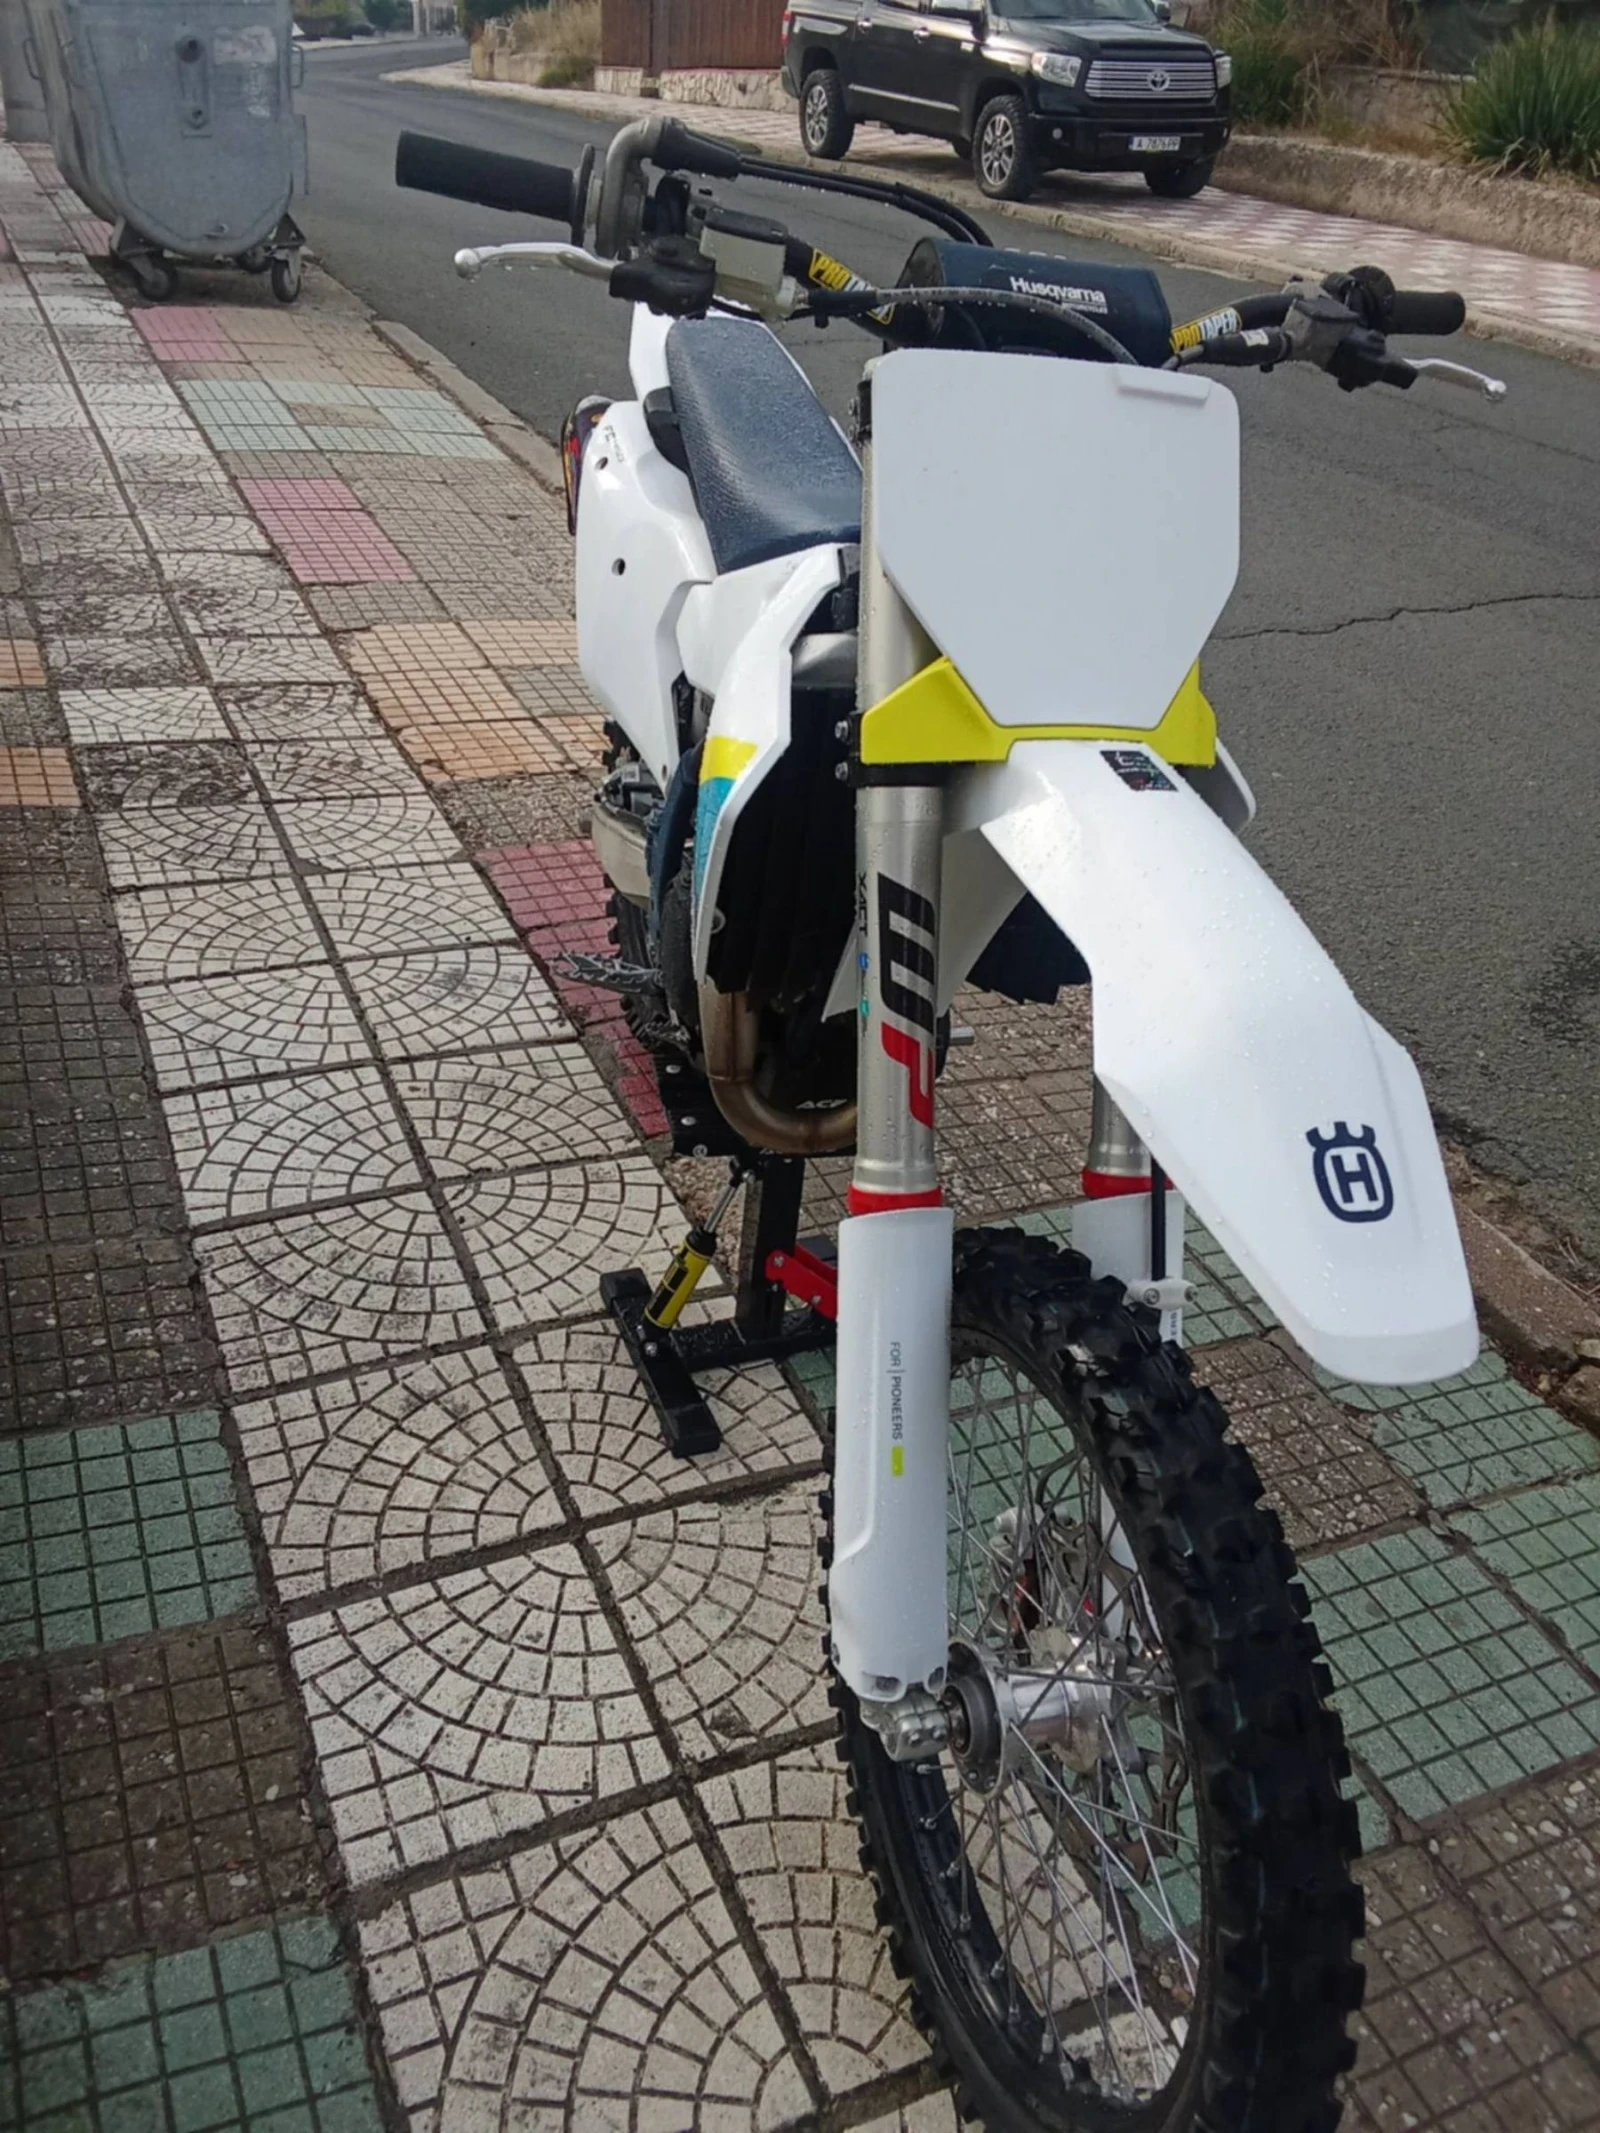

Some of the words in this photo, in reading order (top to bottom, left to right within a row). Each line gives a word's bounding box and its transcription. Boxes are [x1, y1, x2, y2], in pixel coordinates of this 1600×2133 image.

[1009, 276, 1106, 302] Husqvarna
[1173, 307, 1238, 349] PROTAPER
[858, 871, 868, 937] XACT
[889, 1341, 902, 1367] FOR
[891, 1375, 904, 1440] PIONEERS
